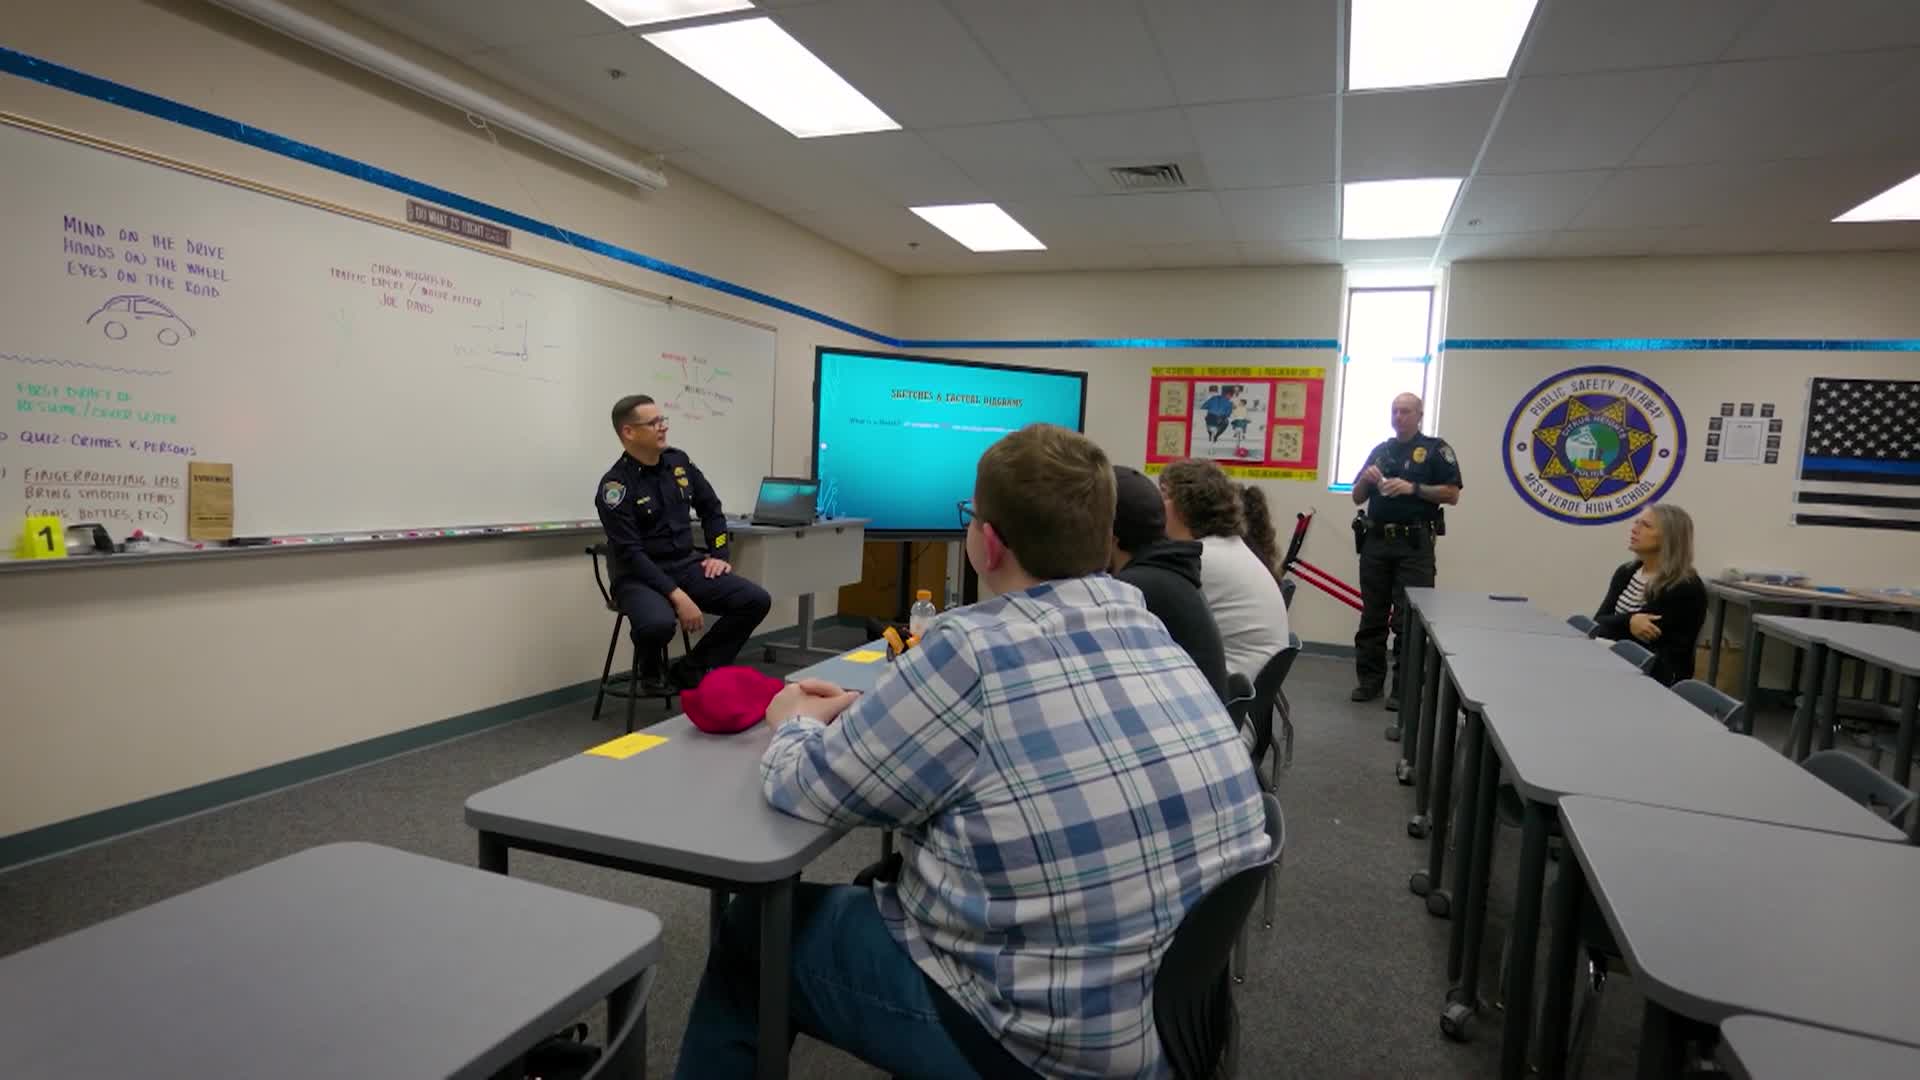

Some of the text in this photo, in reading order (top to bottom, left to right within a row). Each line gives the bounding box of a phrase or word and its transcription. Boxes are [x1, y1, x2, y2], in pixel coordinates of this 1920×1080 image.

[428, 210, 449, 227] WHAT
[450, 216, 461, 231] IS
[64, 215, 225, 260] MIND ON THE DRIVE
[64, 237, 230, 283] HANDS ON THE WHEEL
[67, 261, 221, 298] EYES ON THE ROAD
[380, 292, 398, 308] JOE
[891, 389, 934, 401] SKETCHES
[945, 392, 980, 404] FACTUAL
[983, 396, 1023, 409] DIAGRAMS
[1530, 378, 1664, 420] PUBLIC SAFETY PATHWAY
[1561, 415, 1627, 439] CITRUS HEIGHTS
[71, 433, 122, 449] CRIMES
[143, 440, 198, 457] PERSONS
[154, 474, 180, 489] LAB
[1524, 472, 1657, 514] MESA VERDE HIGH SCHOOL
[24, 485, 176, 506] BRING SMOOTH ITEMS
[38, 525, 55, 552] 1
